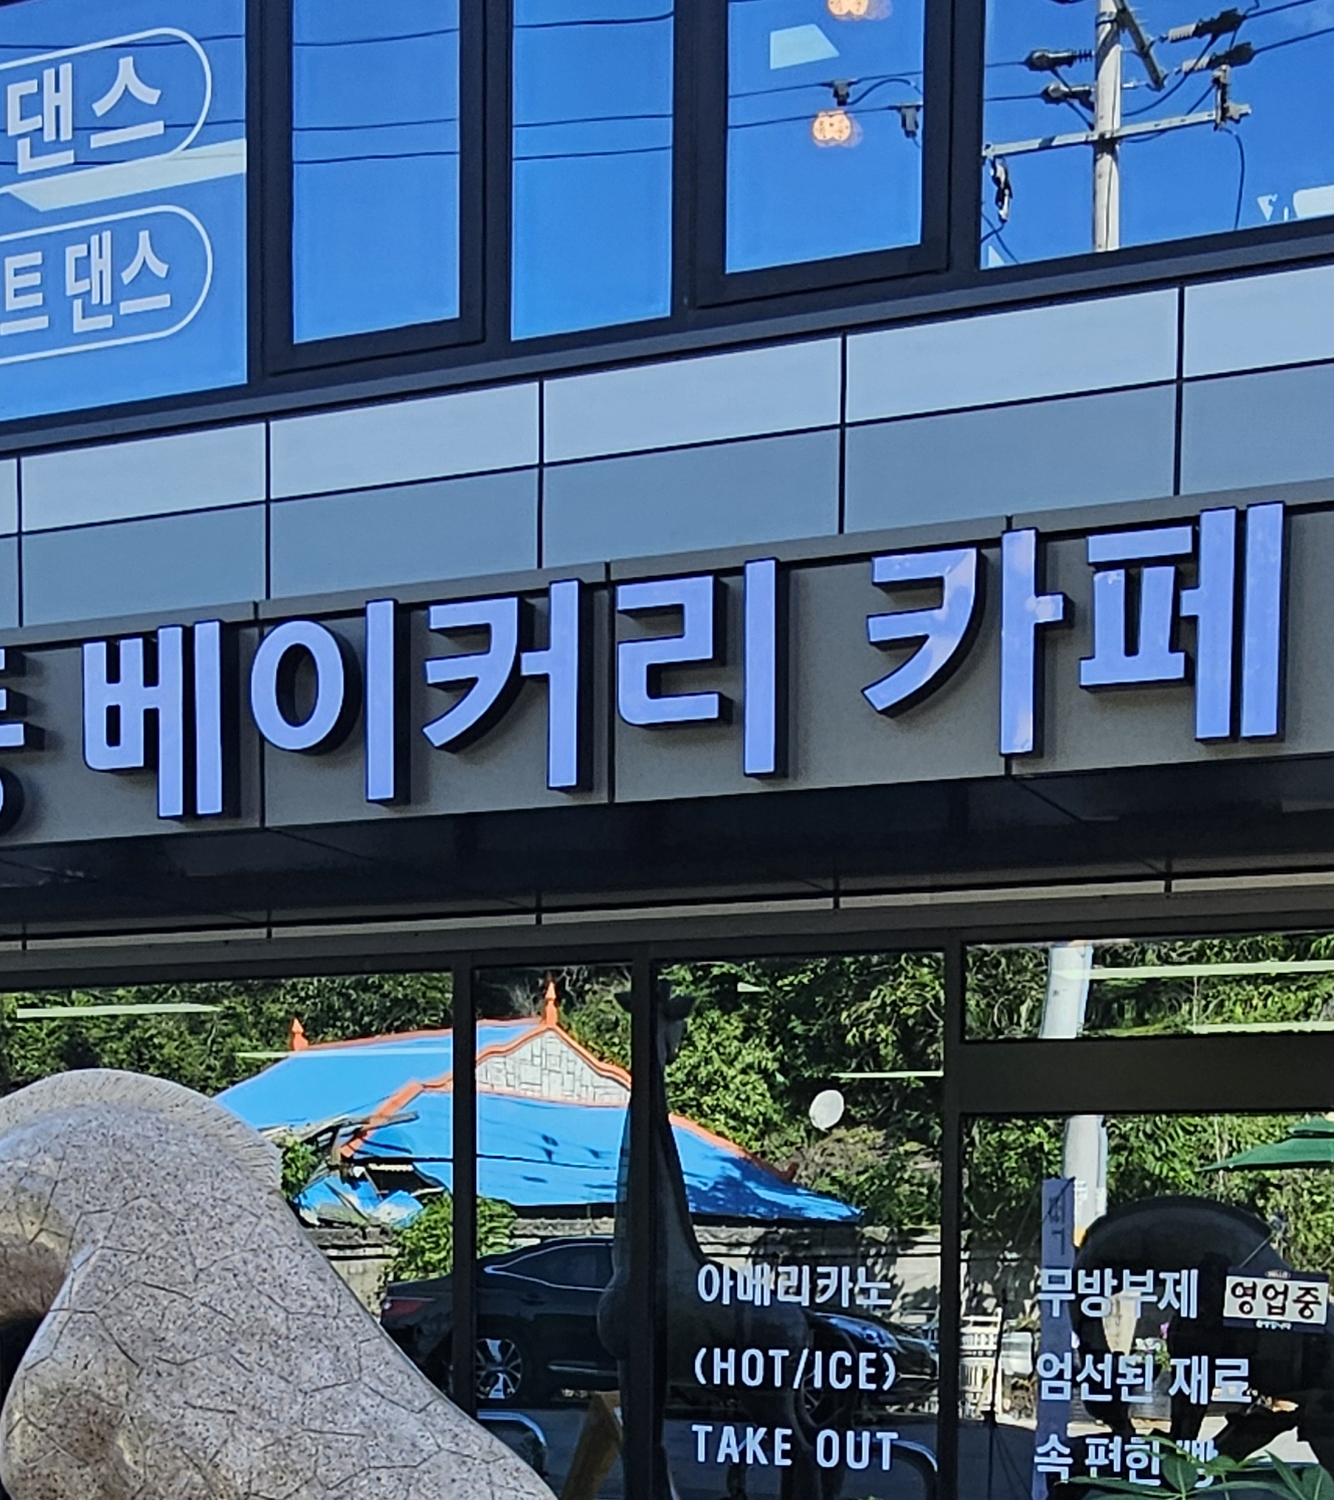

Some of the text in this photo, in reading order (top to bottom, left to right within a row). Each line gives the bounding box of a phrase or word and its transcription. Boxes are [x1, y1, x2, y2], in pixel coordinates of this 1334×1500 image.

[65, 230, 171, 333] 댄스
[81, 556, 779, 819] 베이커리
[861, 502, 1285, 756] 카페
[697, 1264, 893, 1308] 아메리카노
[1037, 1268, 1199, 1320] 무방부제
[1230, 1280, 1323, 1319] 영업중
[694, 1347, 897, 1391] (HOT/ICE)
[1035, 1352, 1253, 1406] 엄선된 재료
[692, 1424, 899, 1471] TAKE OUT
[1033, 1433, 1074, 1484] 속
